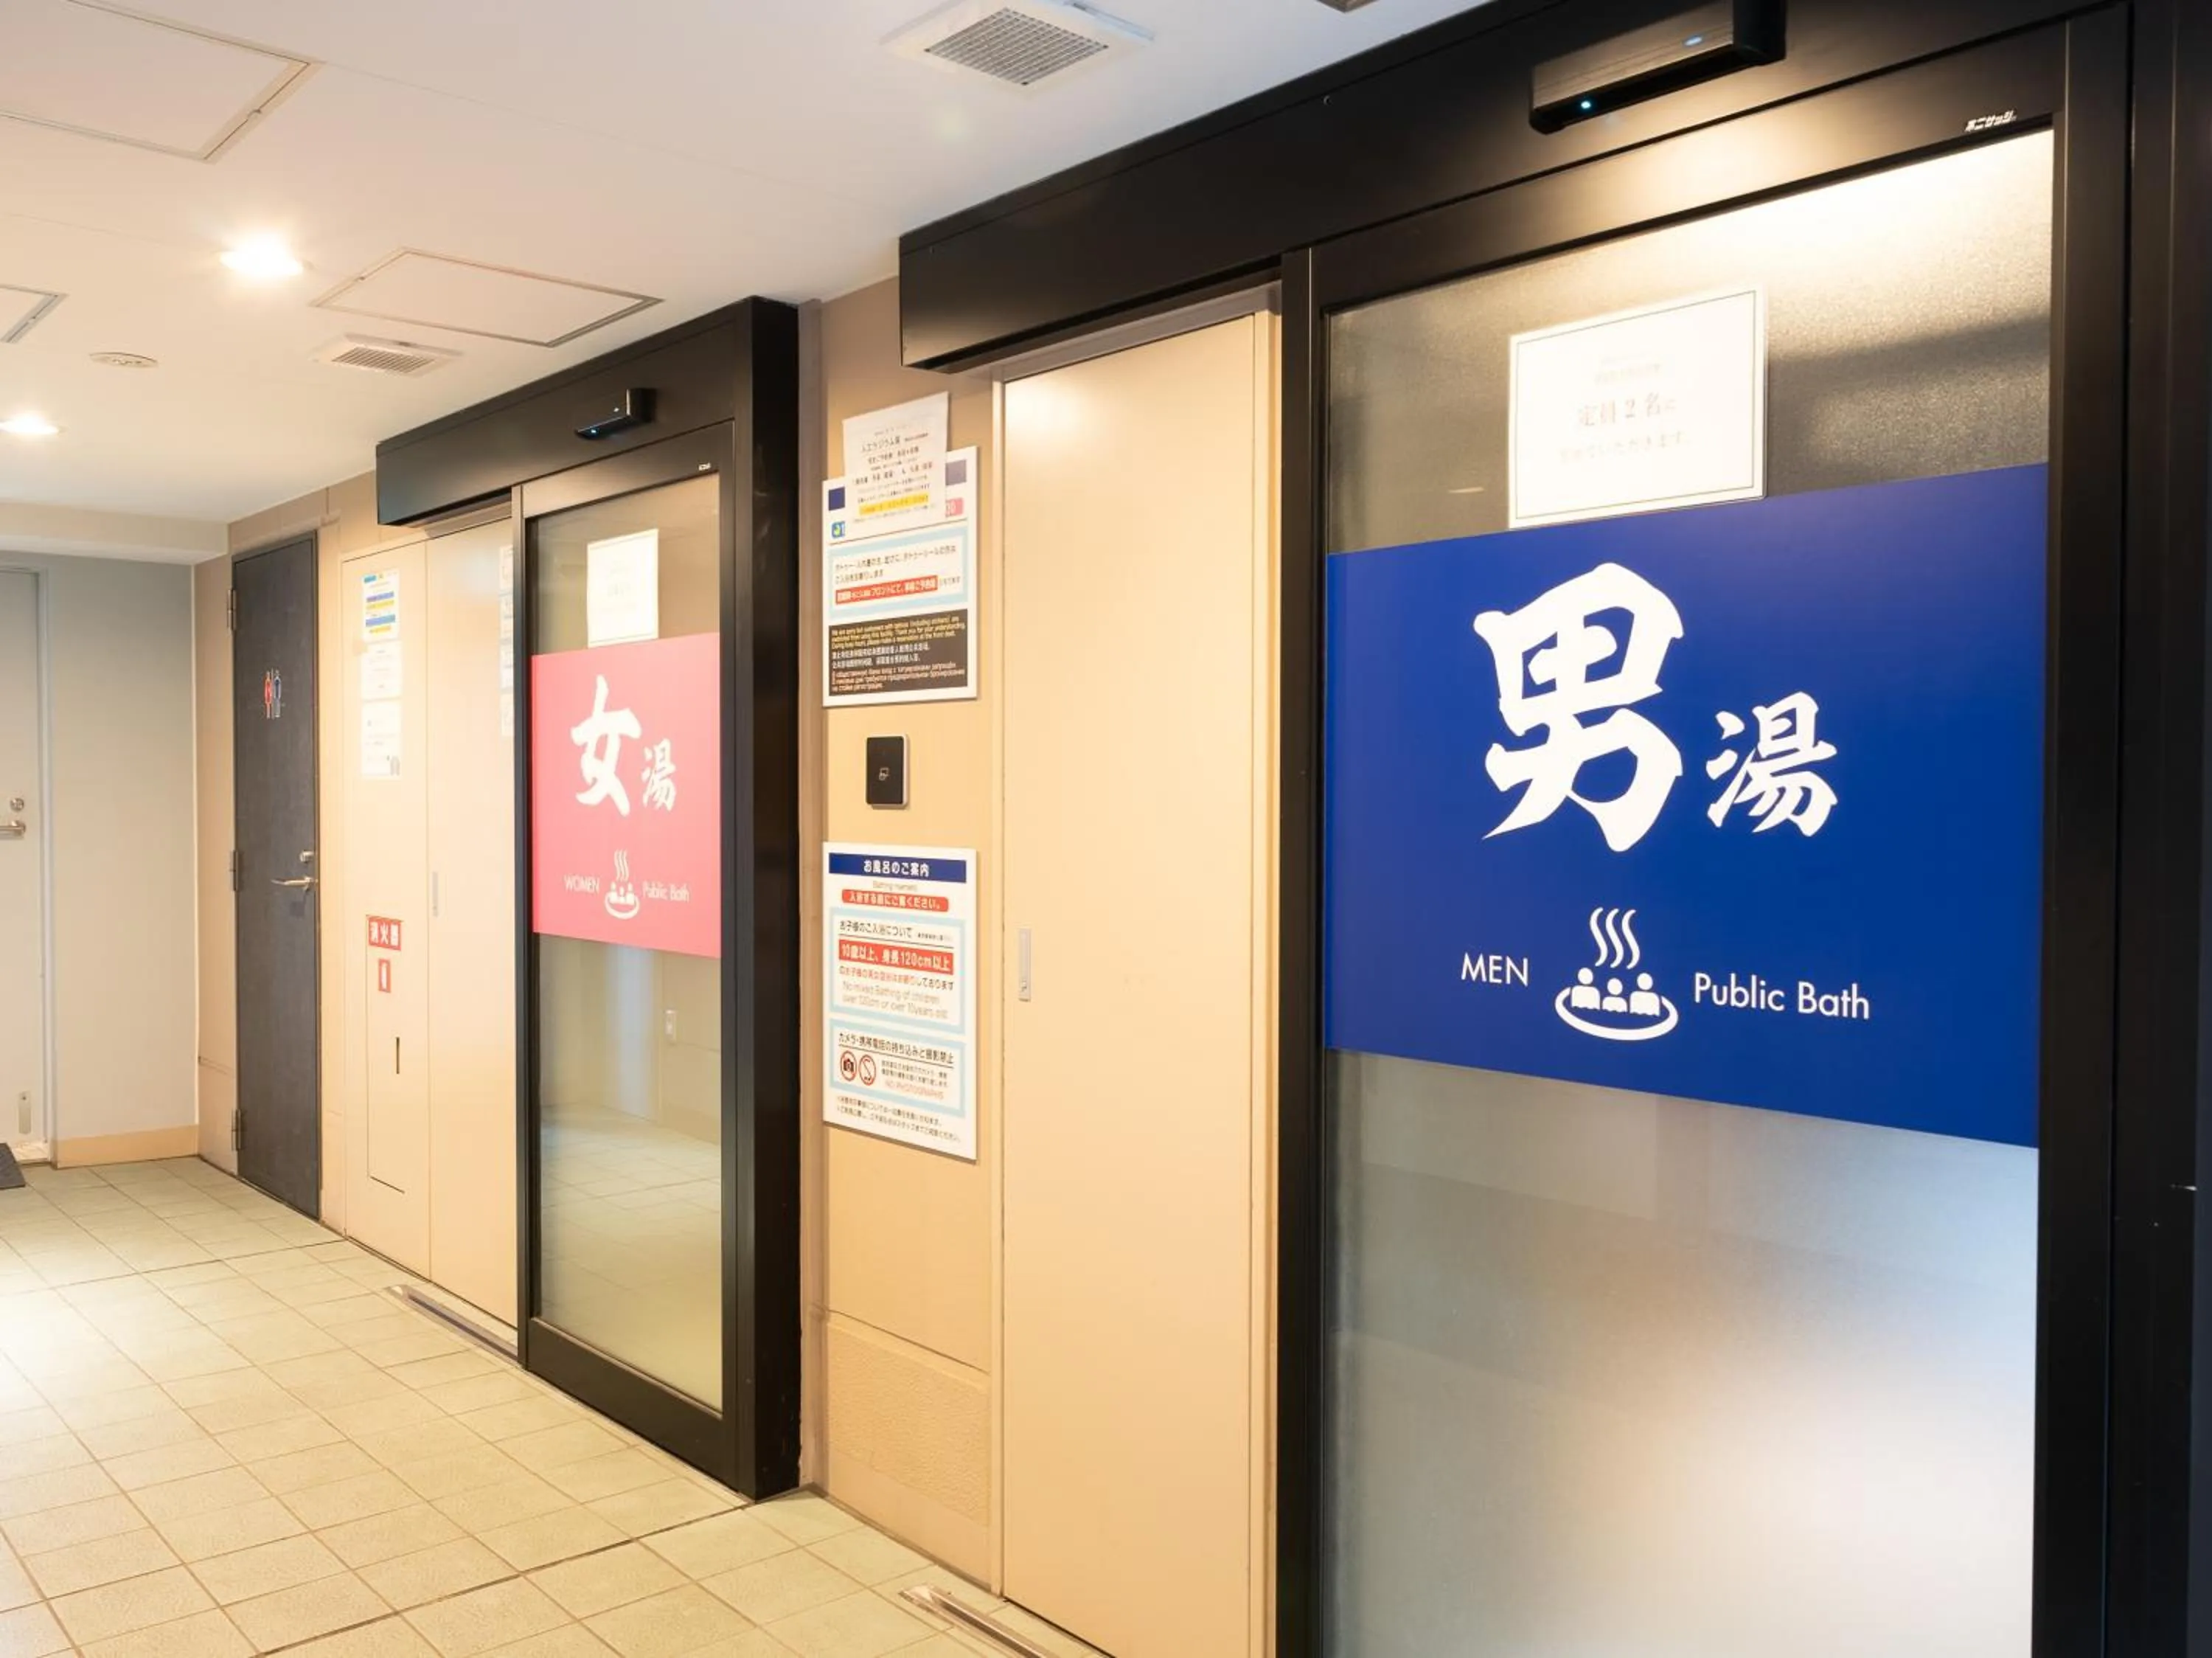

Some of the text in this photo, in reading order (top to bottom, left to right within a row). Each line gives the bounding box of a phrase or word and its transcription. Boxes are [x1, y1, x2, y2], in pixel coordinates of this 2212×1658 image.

[1475, 563, 1837, 851] 男湯
[571, 675, 676, 816] 女湯
[563, 873, 690, 903] WOMEN Public Bath
[863, 859, 929, 877] お風呂のご案内
[1461, 952, 1870, 1019] MEN Public Bath
